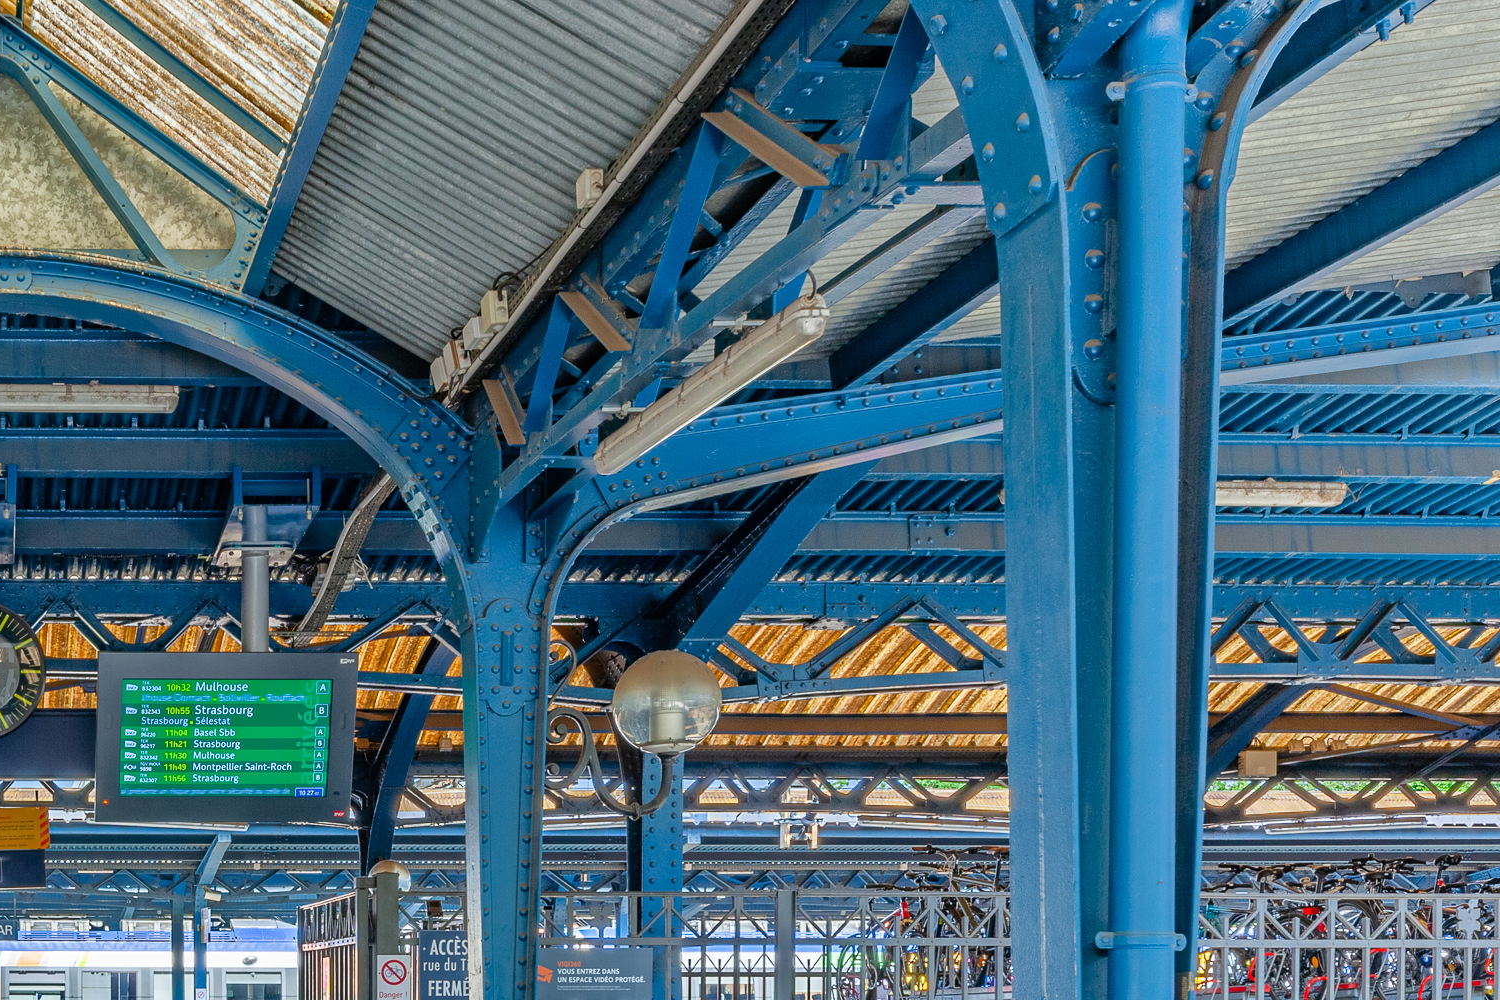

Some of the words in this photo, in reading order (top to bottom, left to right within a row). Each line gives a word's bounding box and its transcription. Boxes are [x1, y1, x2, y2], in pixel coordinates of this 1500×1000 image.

[167, 683, 191, 691] 10h32
[195, 682, 248, 691] Mulhouse
[320, 683, 326, 691] A
[195, 705, 254, 717] Strasbourg
[141, 717, 189, 727] Strasbourg
[195, 716, 231, 725] Sélestat
[194, 728, 216, 737] Basel
[219, 728, 236, 737] Sbb
[193, 740, 240, 750] Strasbourg
[193, 751, 236, 760] Mulhouse
[192, 763, 243, 772] Montpellier
[245, 763, 292, 771] Saint-Roch
[192, 774, 239, 784] Strasbourg
[430, 936, 468, 955] ACCÈS
[423, 961, 440, 971] rue
[444, 957, 457, 971] du
[461, 958, 469, 971] Ti
[594, 975, 613, 983] VIDÉO
[615, 975, 646, 983] PROTÉGÉ.
[428, 977, 469, 997] FERMÉ
[379, 991, 403, 999] Danger
